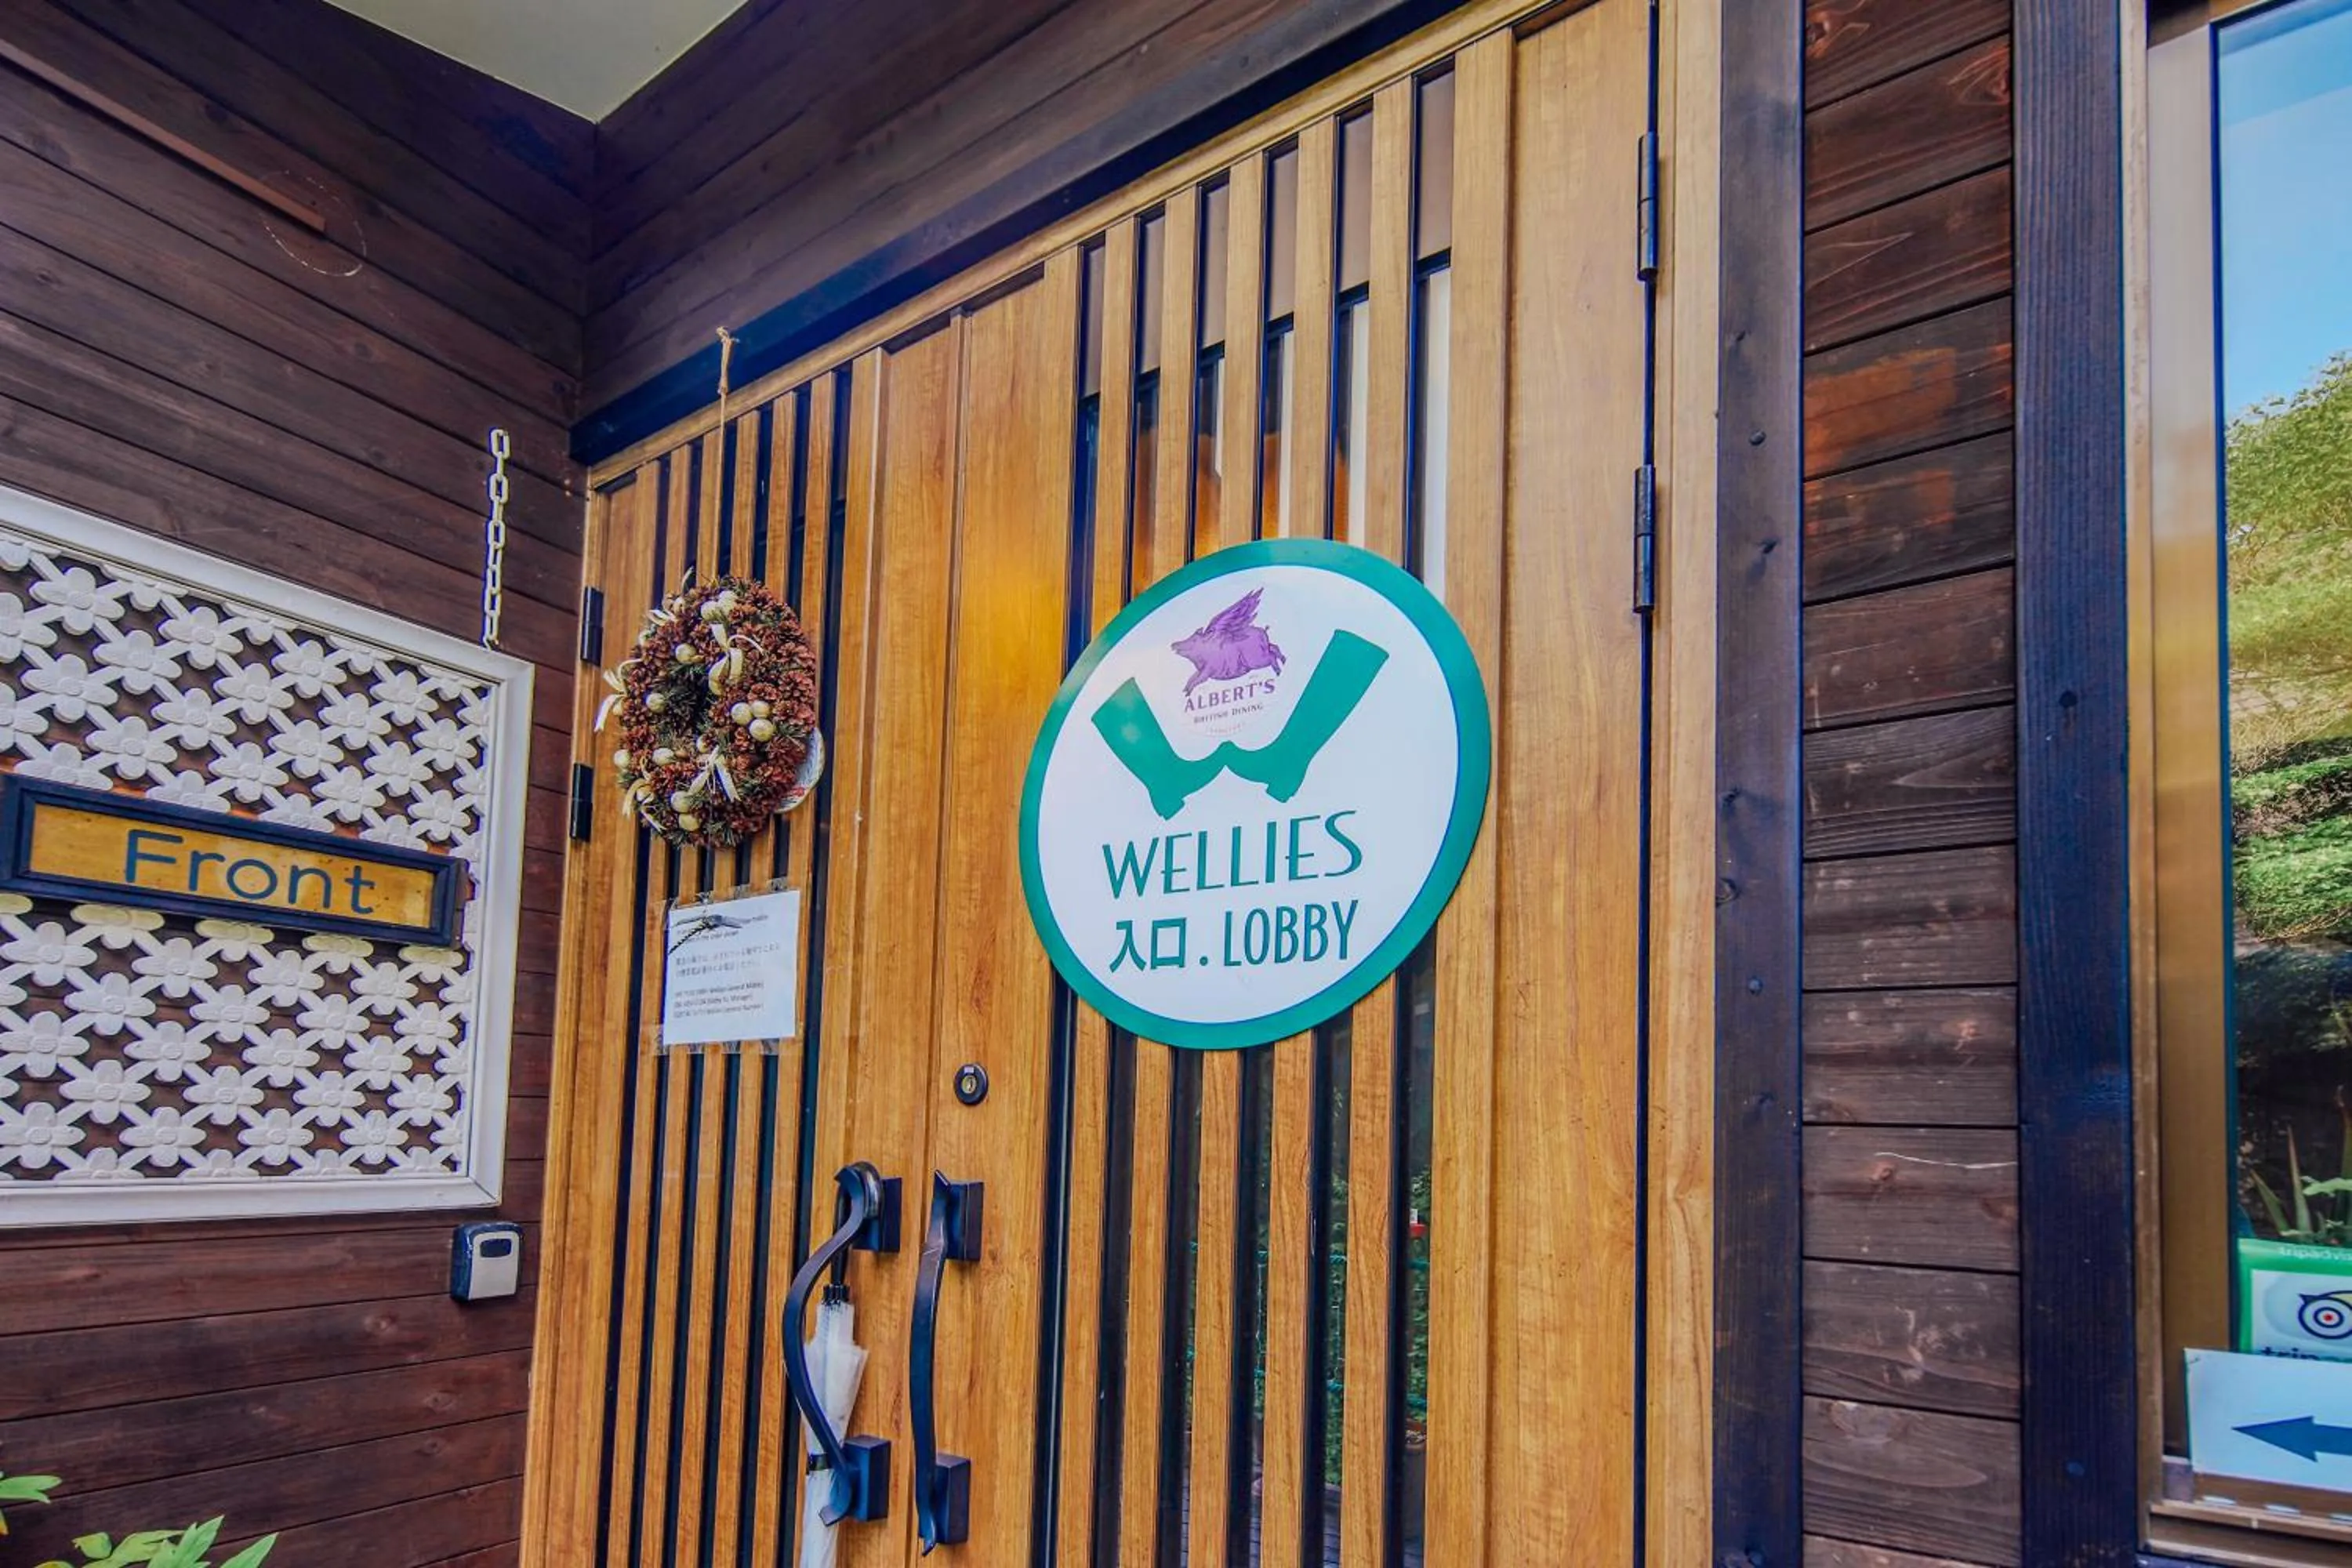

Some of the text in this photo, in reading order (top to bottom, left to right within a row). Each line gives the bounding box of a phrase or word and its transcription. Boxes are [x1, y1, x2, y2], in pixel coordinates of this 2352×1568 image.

[1184, 679, 1276, 713] ALBERT'S
[1232, 703, 1264, 716] DINING
[125, 828, 376, 914] Front
[1102, 810, 1363, 899] WELLIES
[1223, 899, 1359, 967] LOBBY
